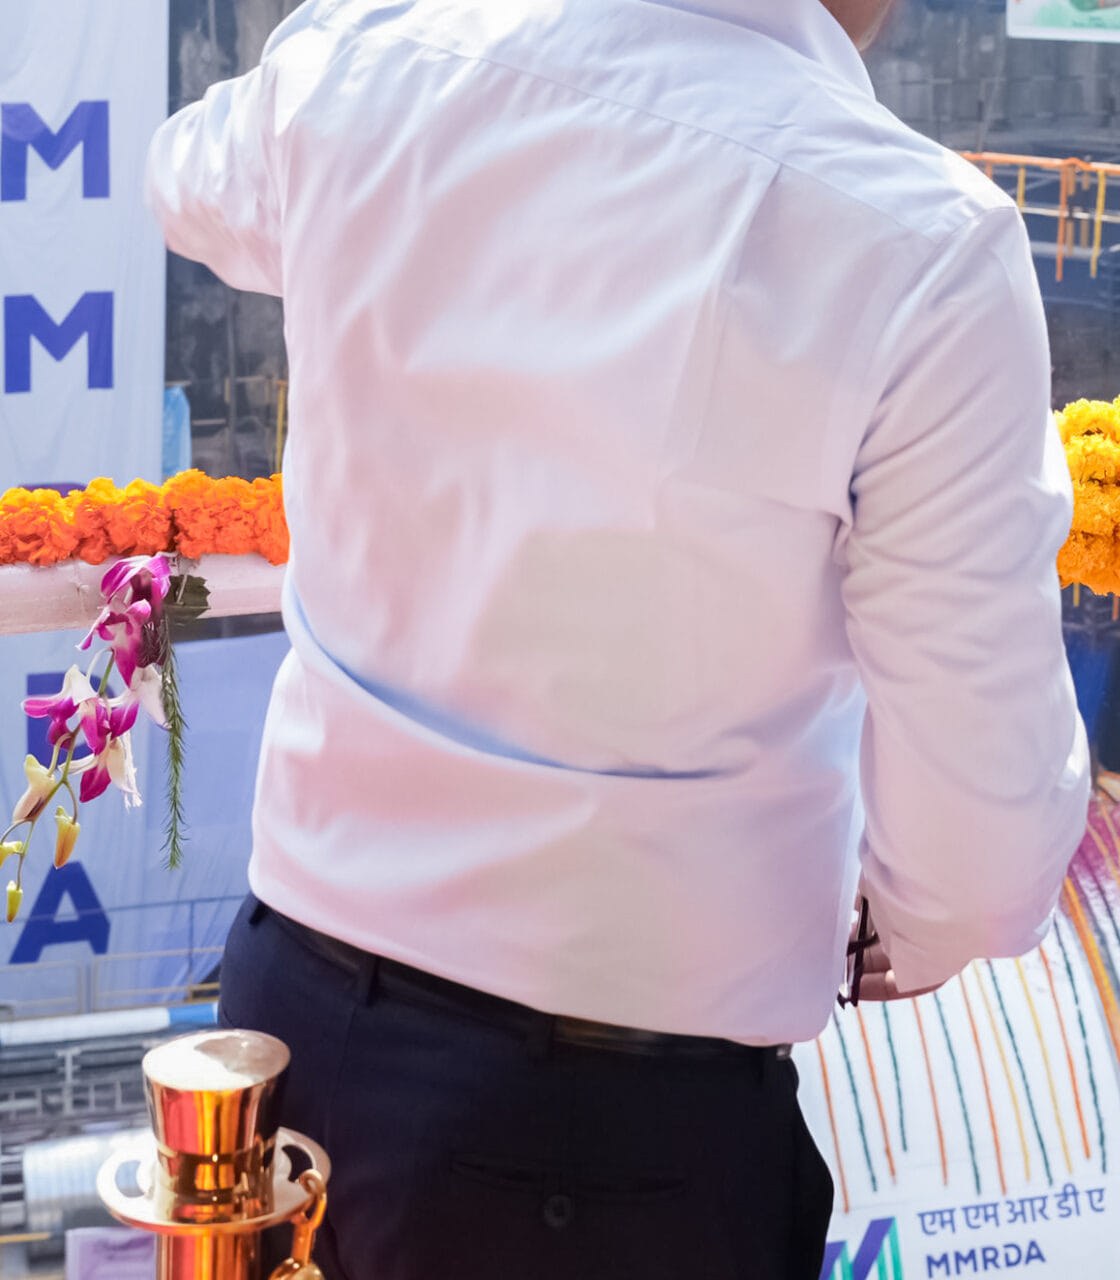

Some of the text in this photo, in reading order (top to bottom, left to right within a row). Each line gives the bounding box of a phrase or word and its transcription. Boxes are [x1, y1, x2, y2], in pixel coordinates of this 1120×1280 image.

[917, 1181, 1107, 1237] एम एम आर डी ए
[926, 1238, 1047, 1280] MMRDA
